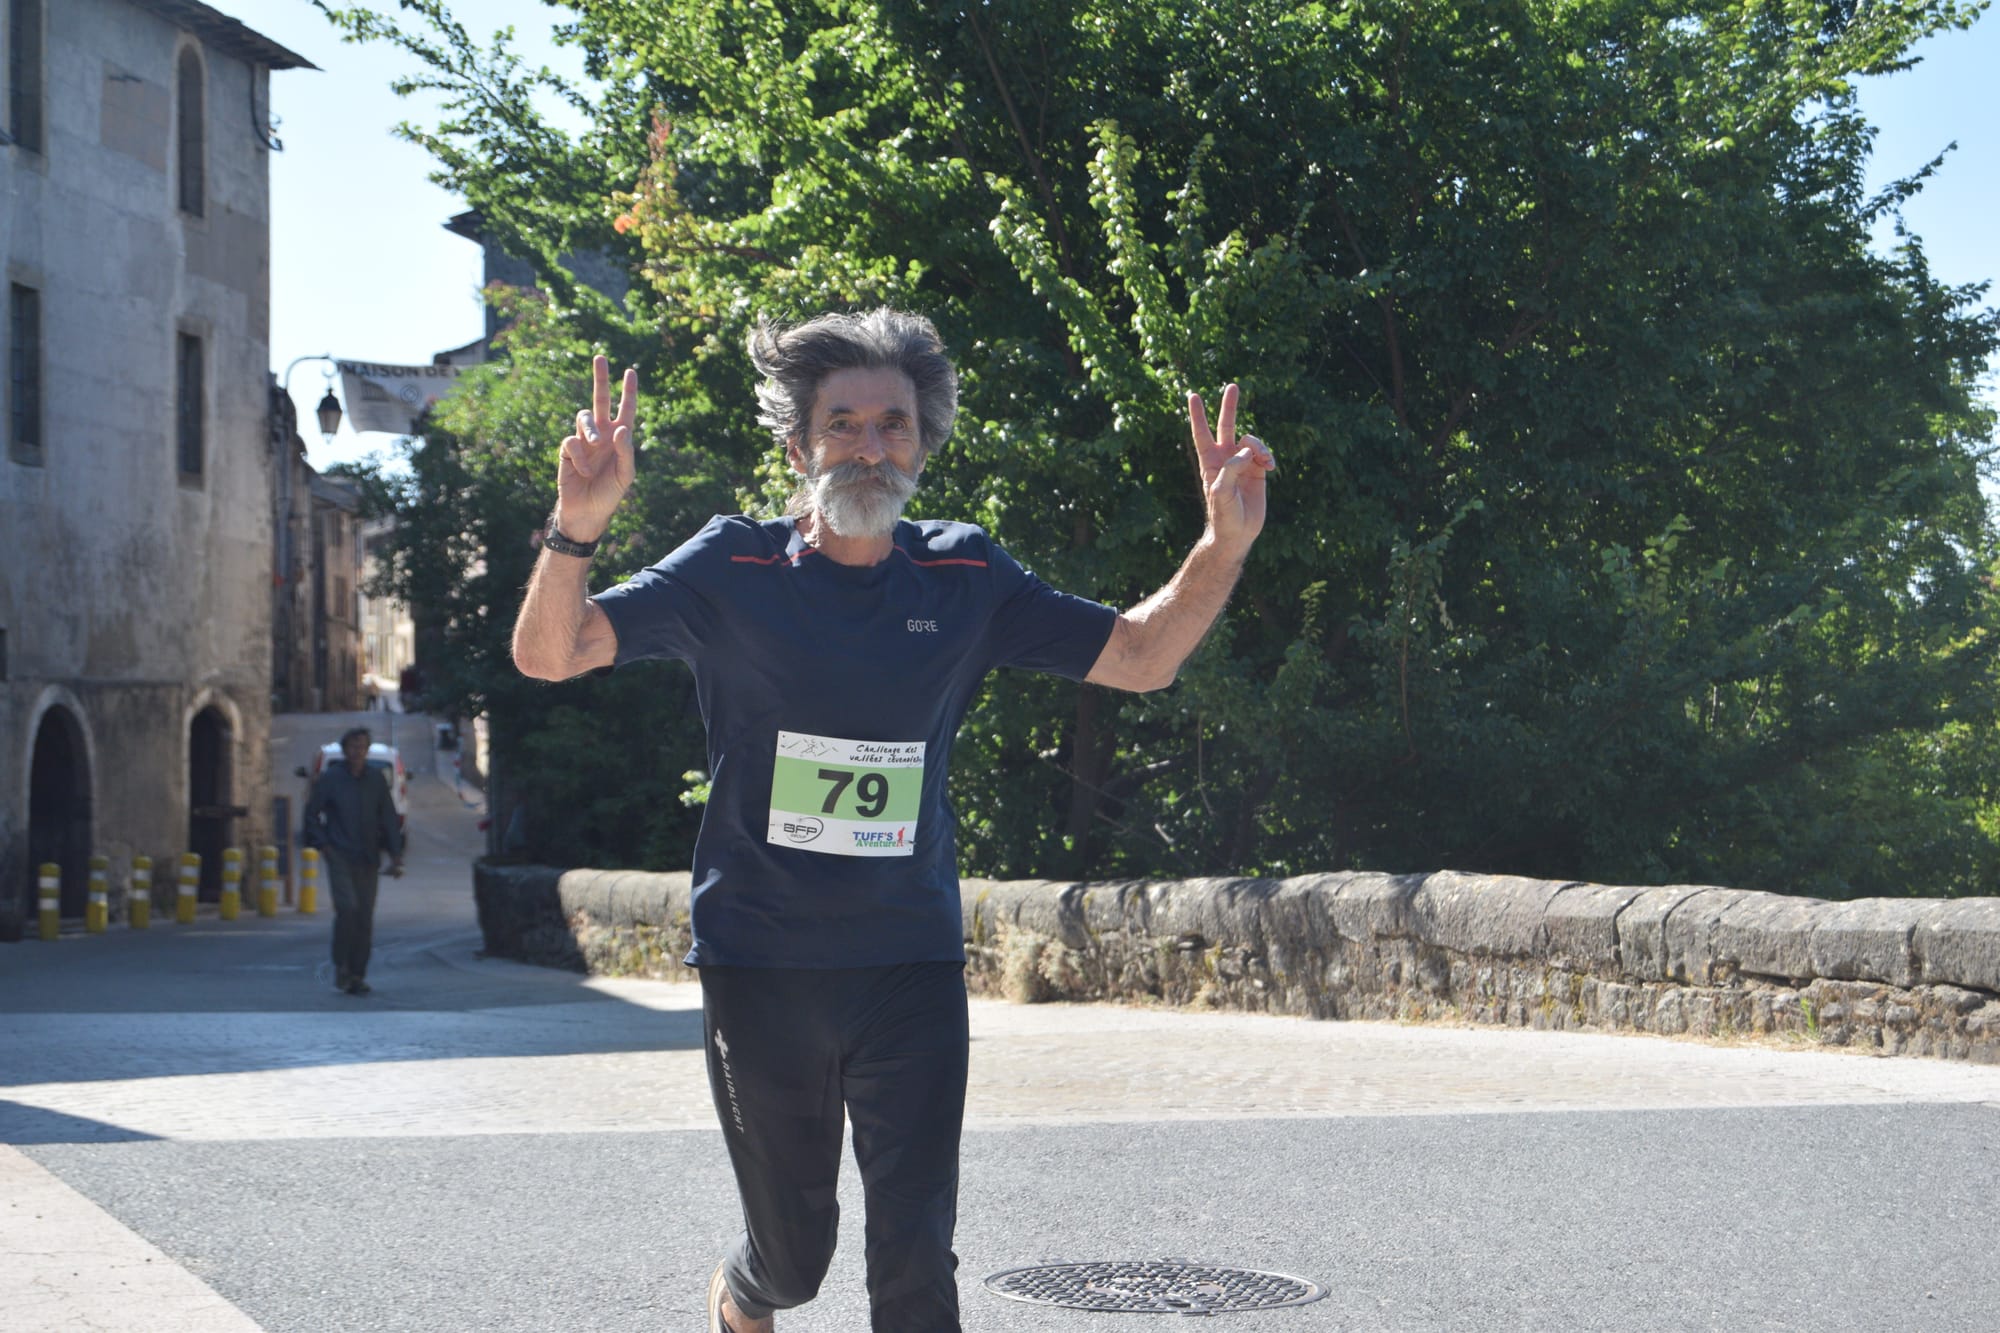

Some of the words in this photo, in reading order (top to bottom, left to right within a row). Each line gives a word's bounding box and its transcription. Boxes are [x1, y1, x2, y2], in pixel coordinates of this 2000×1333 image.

[342, 363, 419, 377] MAISON
[425, 367, 446, 377] DE
[907, 619, 938, 632] GORE
[817, 768, 889, 818] 79
[783, 823, 818, 835] BFP
[852, 831, 894, 841] TUFF'S
[722, 1060, 745, 1134] RAIDLIGHT
